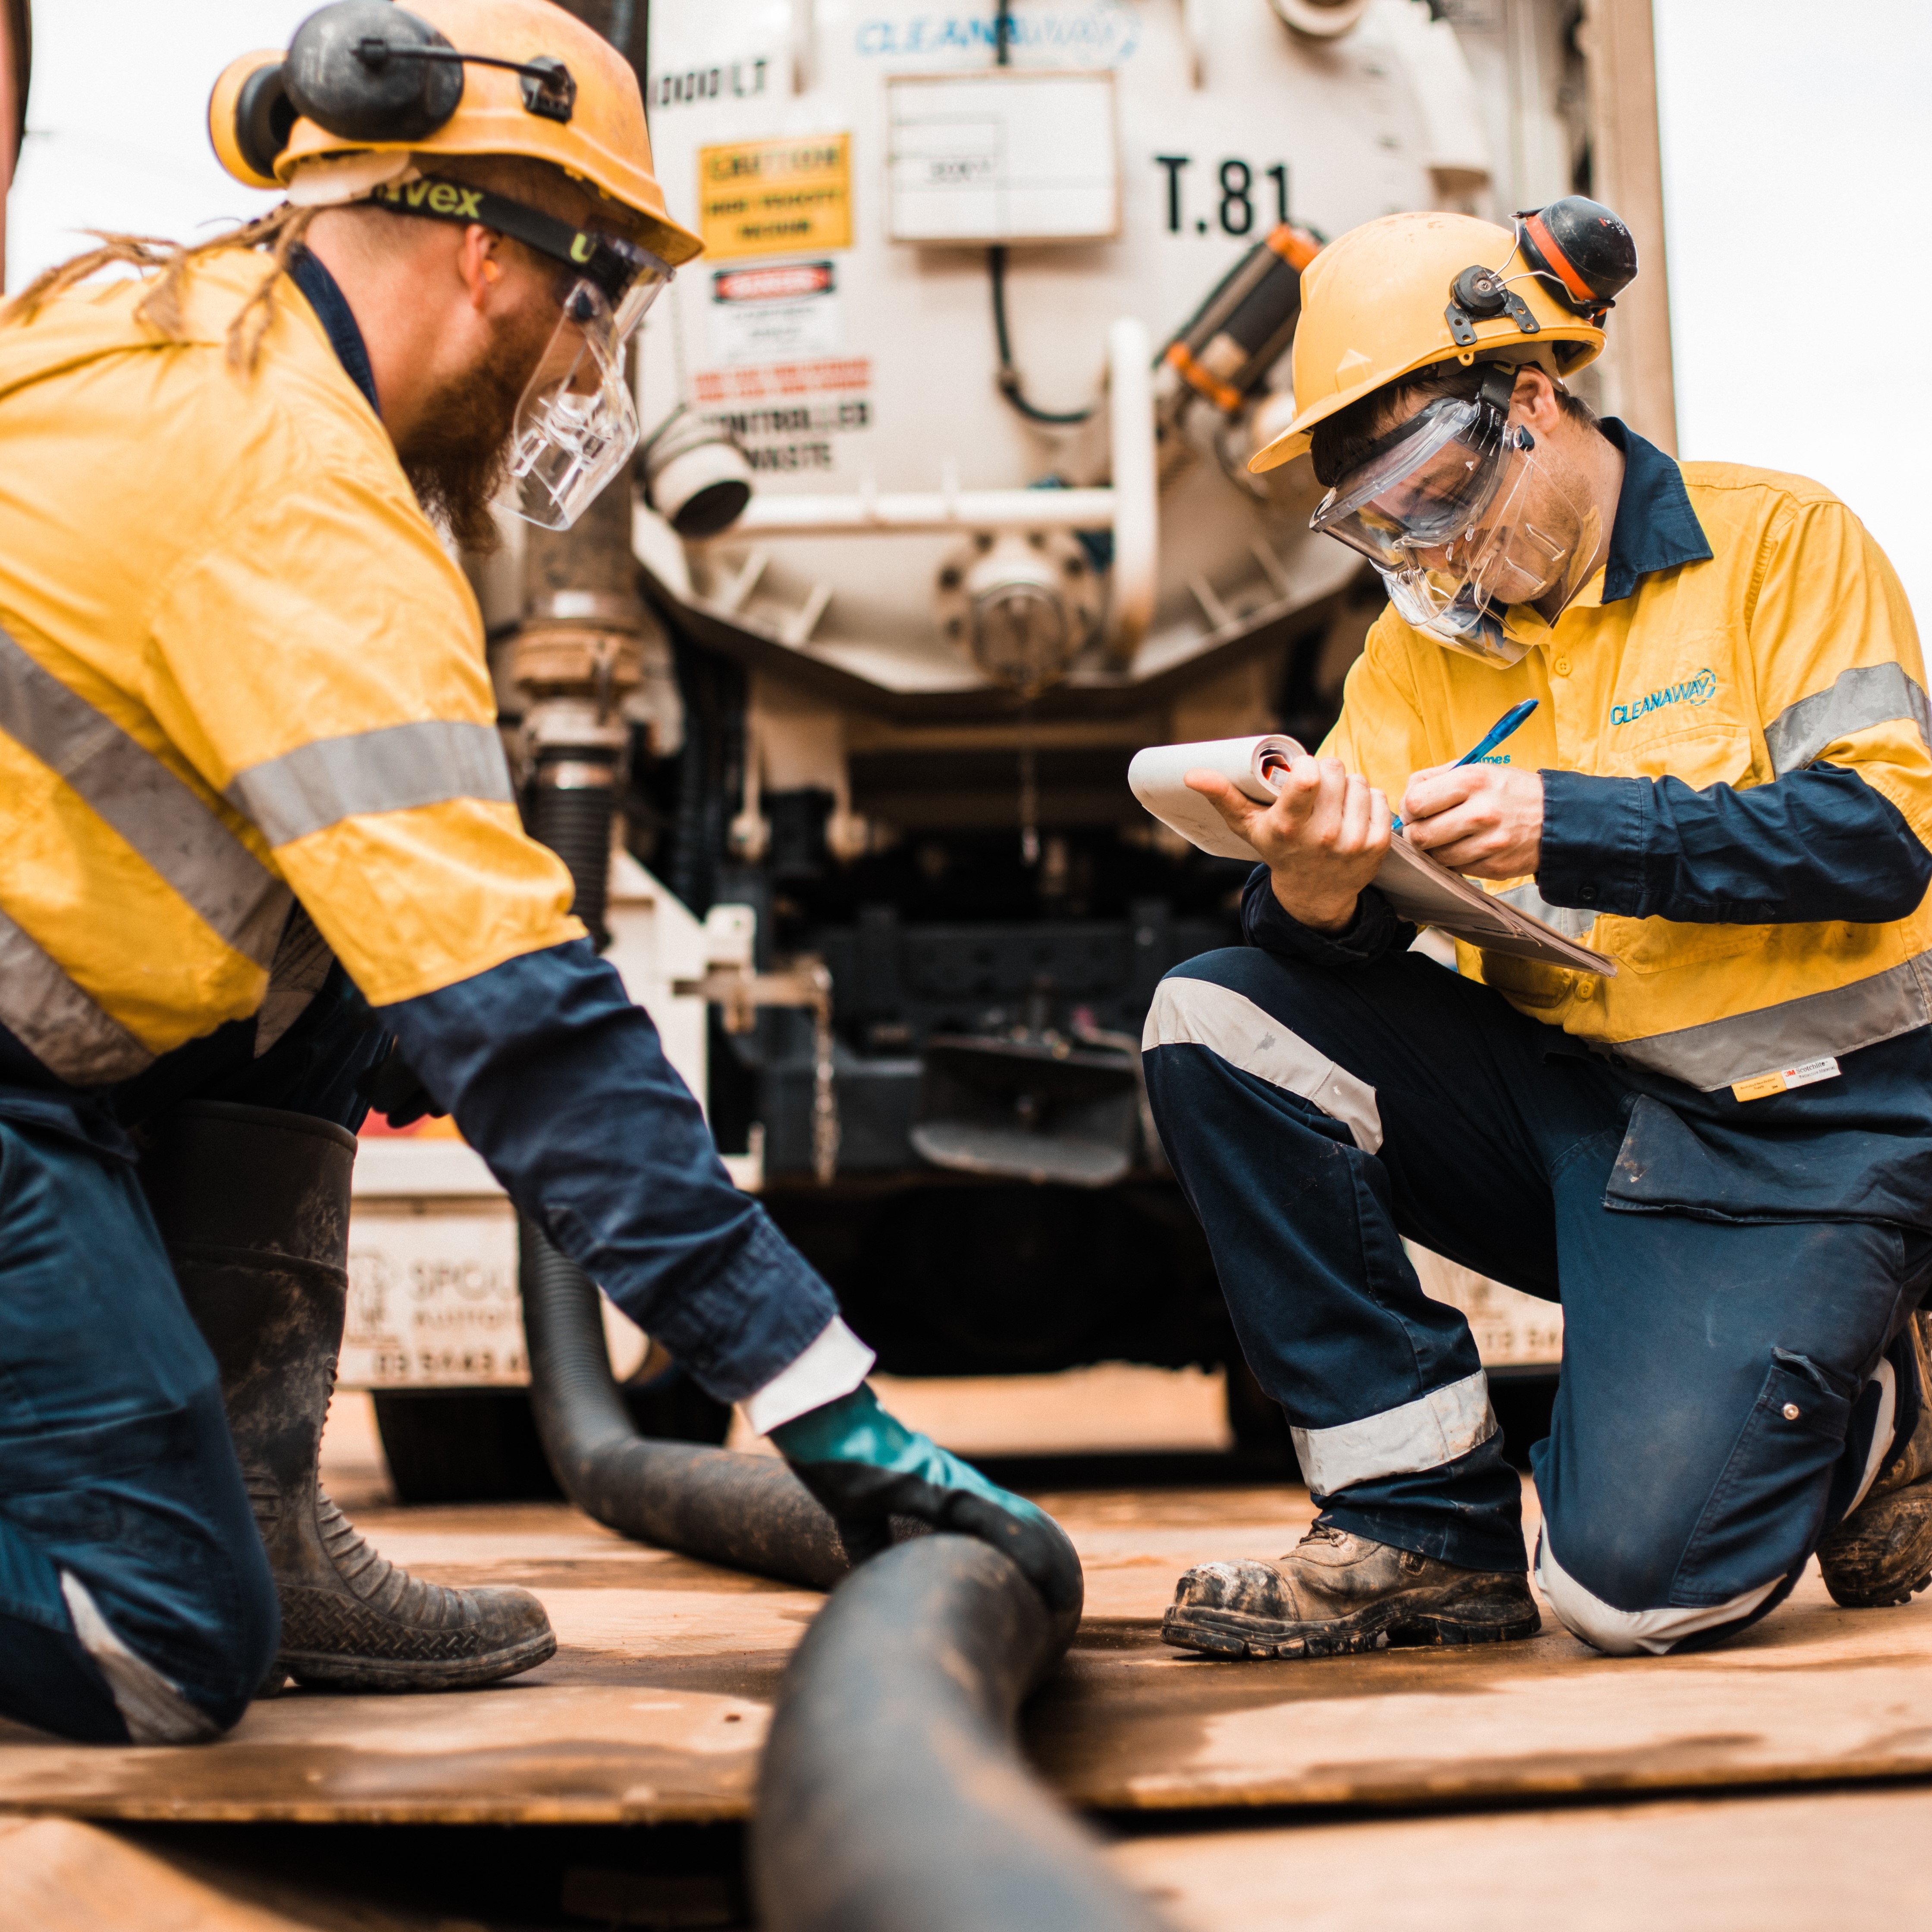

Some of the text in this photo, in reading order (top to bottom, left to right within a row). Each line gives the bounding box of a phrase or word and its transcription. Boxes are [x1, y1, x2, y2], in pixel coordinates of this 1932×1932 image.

[1155, 155, 1286, 235] T.81
[1610, 677, 1709, 725] CLEANAWAY
[1479, 754, 1511, 765] mes
[1796, 1062, 1825, 1074] Scotchlite
